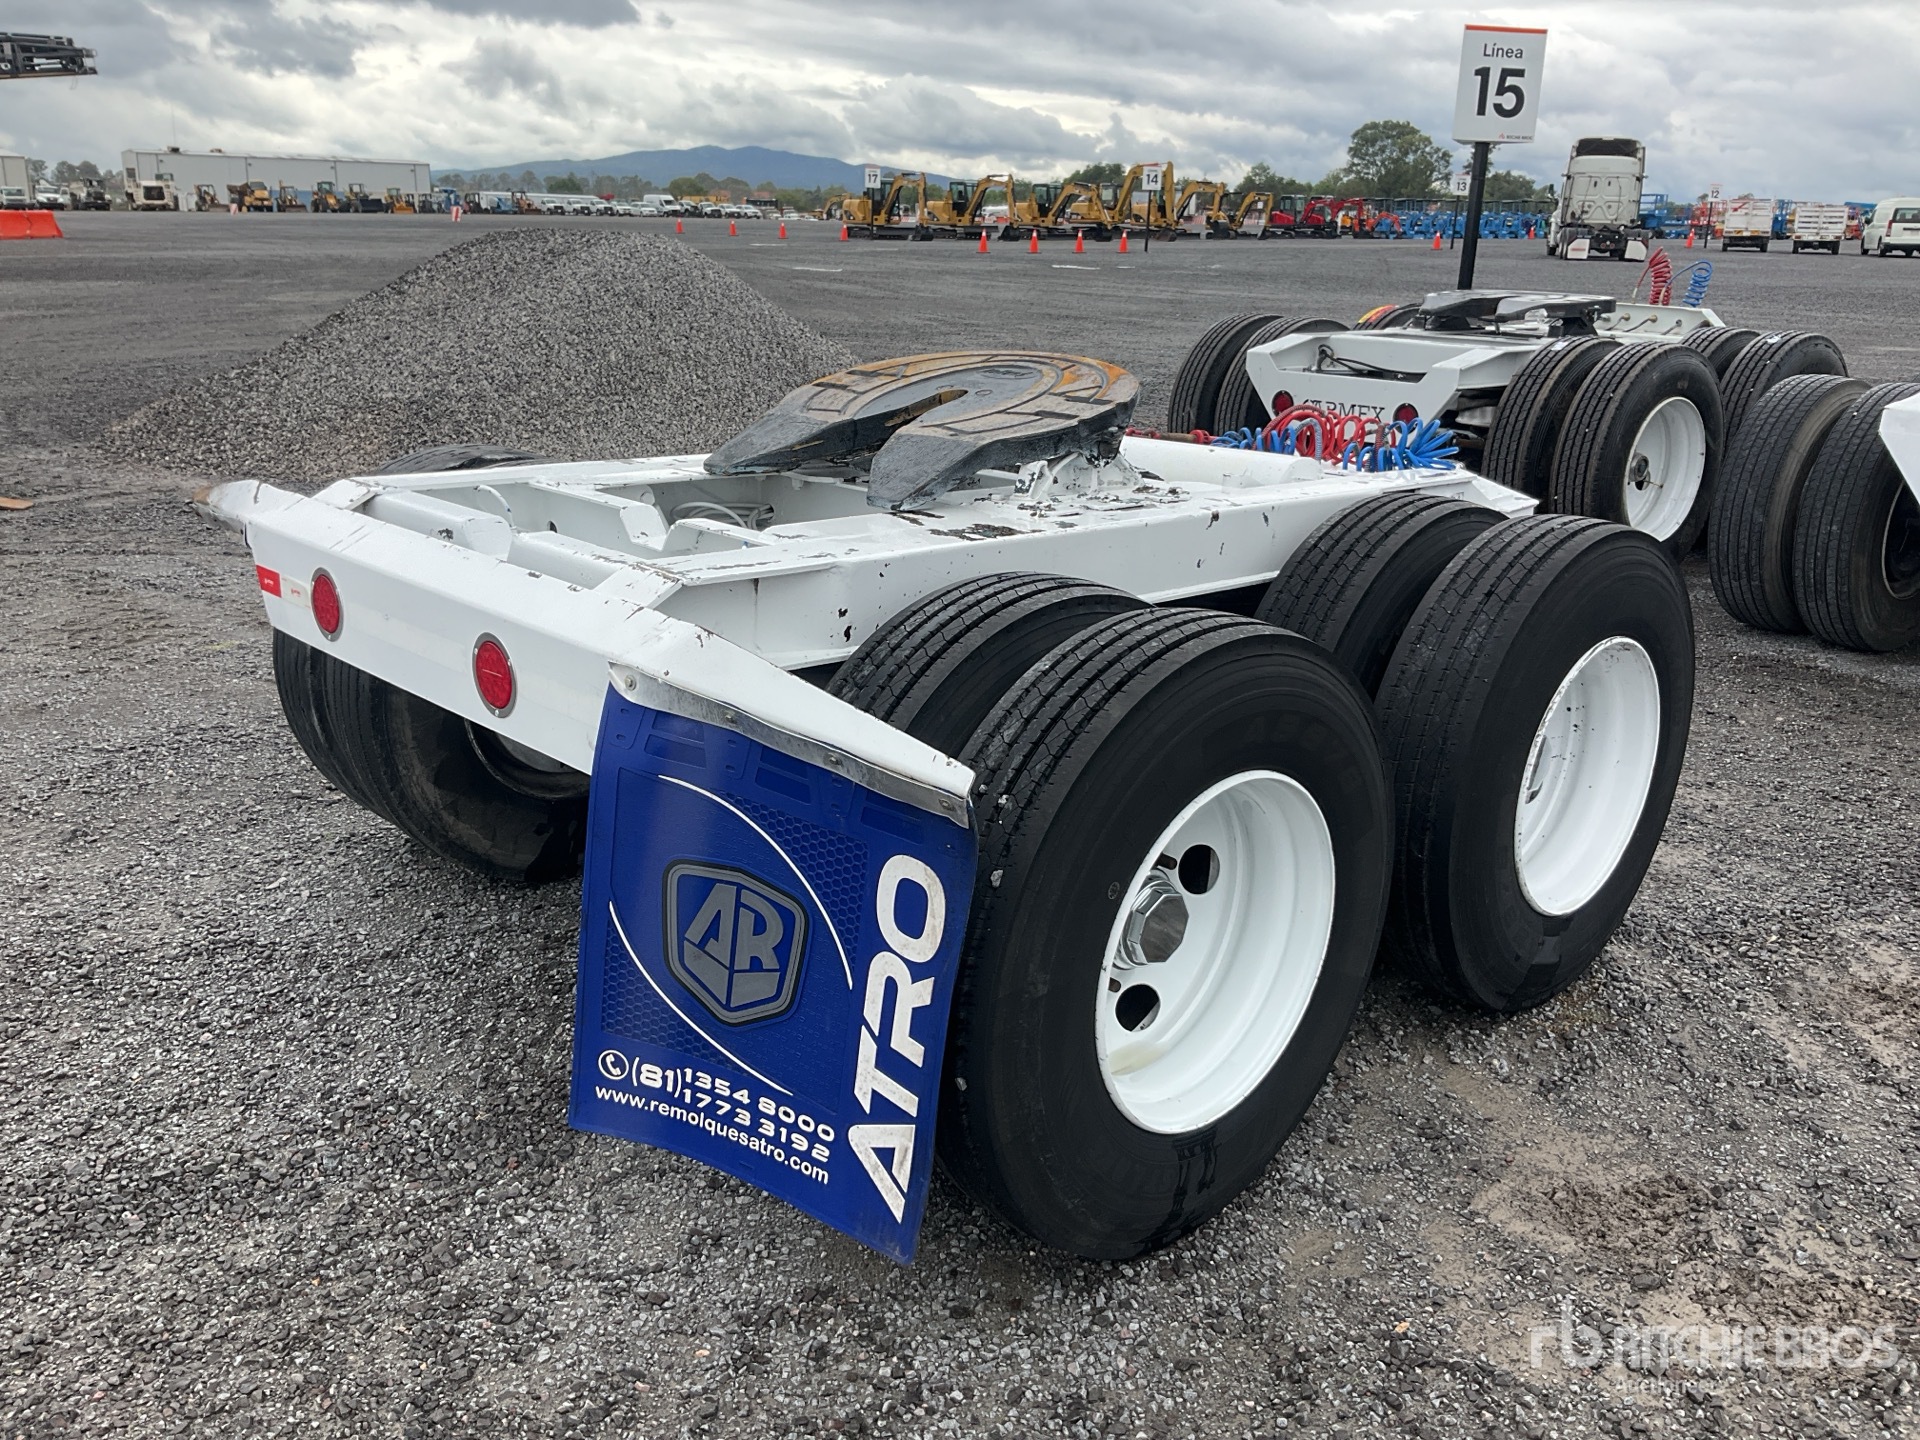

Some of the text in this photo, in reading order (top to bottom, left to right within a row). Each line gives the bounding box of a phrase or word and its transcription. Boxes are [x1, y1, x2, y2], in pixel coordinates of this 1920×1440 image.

[1483, 43, 1524, 59] Línea
[1474, 66, 1526, 118] 15
[868, 173, 879, 184] 17
[1146, 173, 1159, 186] 14
[1456, 181, 1467, 192] 13
[1711, 189, 1720, 199] 12
[847, 854, 947, 1224] ATRO
[683, 1067, 750, 1105] 1354
[758, 1096, 835, 1143] 8000
[595, 1085, 830, 1185] www.remolquesatro.com
[682, 1088, 831, 1163] 1773 3192
